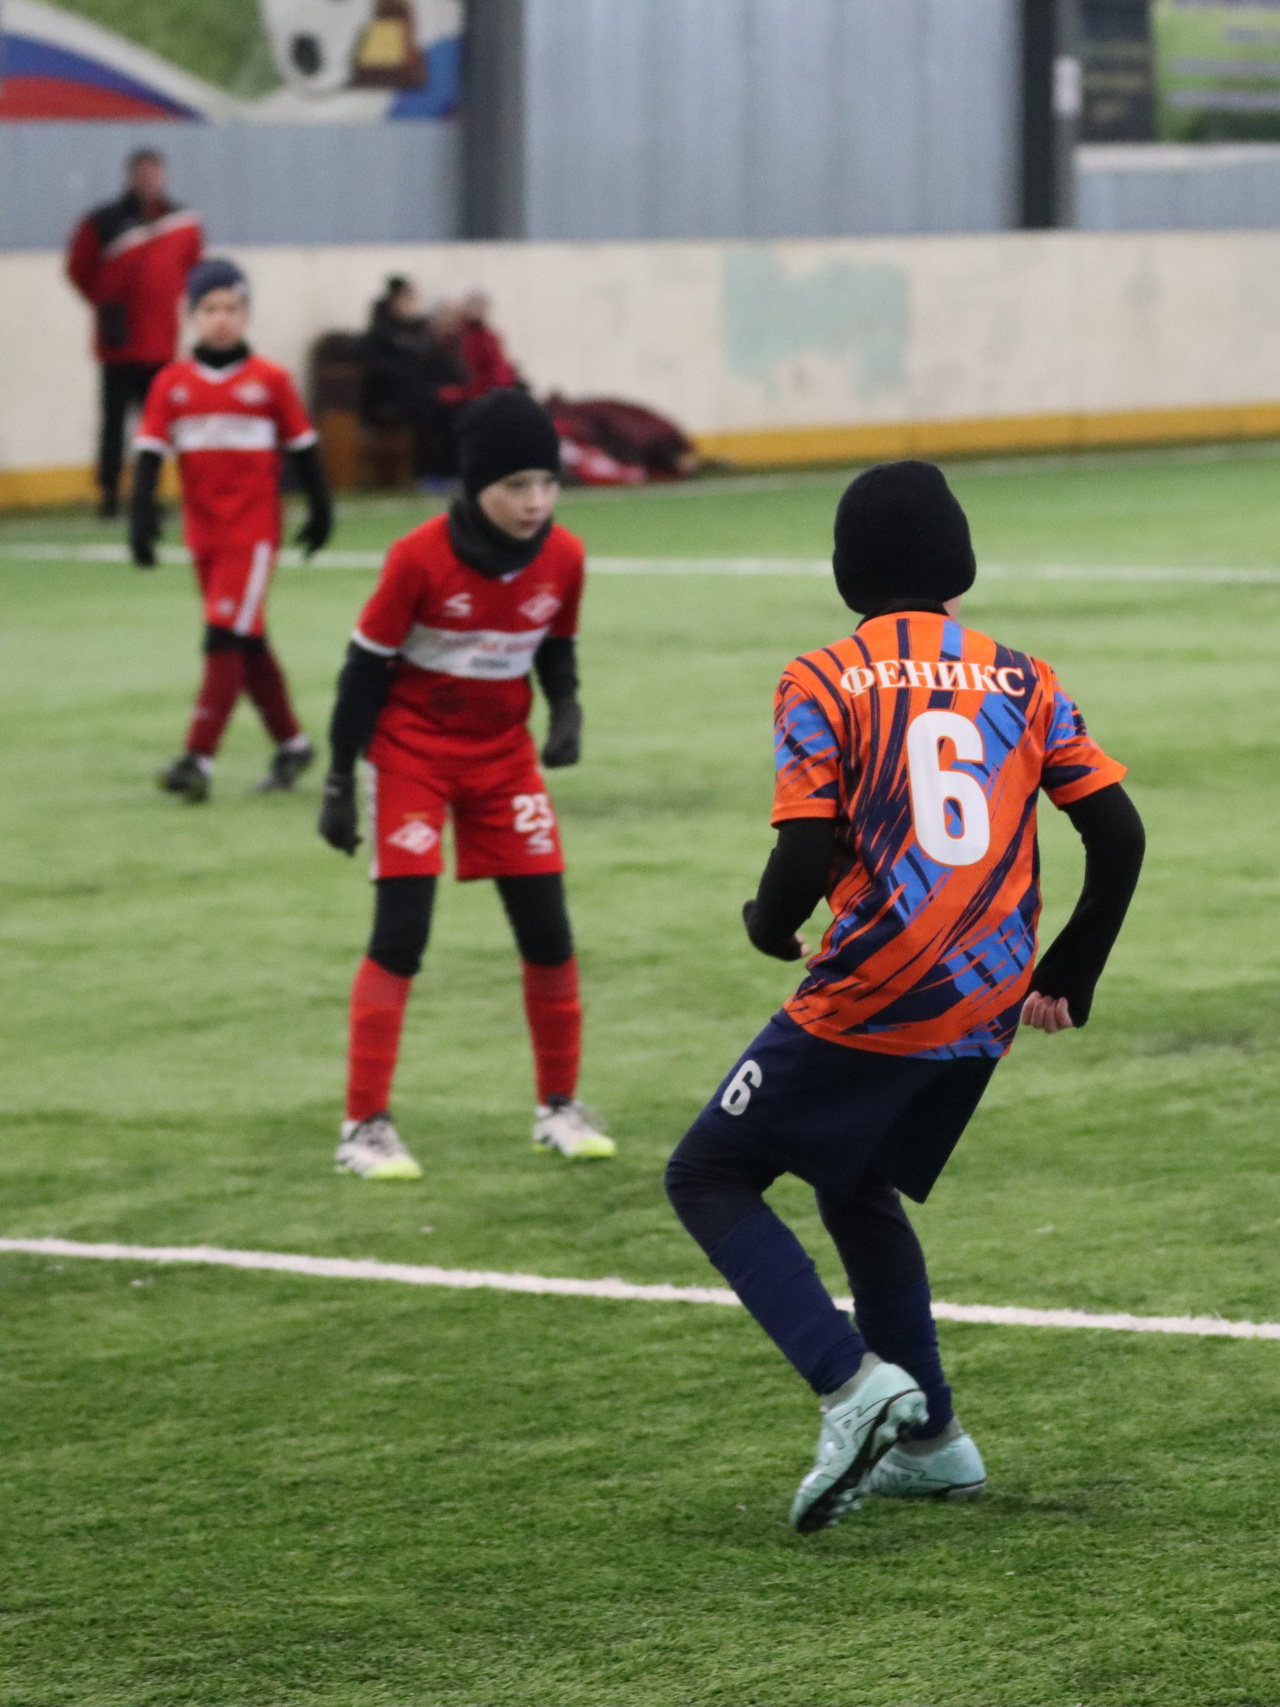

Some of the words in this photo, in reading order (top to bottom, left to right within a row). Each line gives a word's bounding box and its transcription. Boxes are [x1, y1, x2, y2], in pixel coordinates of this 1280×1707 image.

[840, 659, 1026, 698] ФЕНИКС
[906, 710, 990, 866] 6
[512, 793, 553, 832] 23
[721, 1059, 763, 1116] 6
